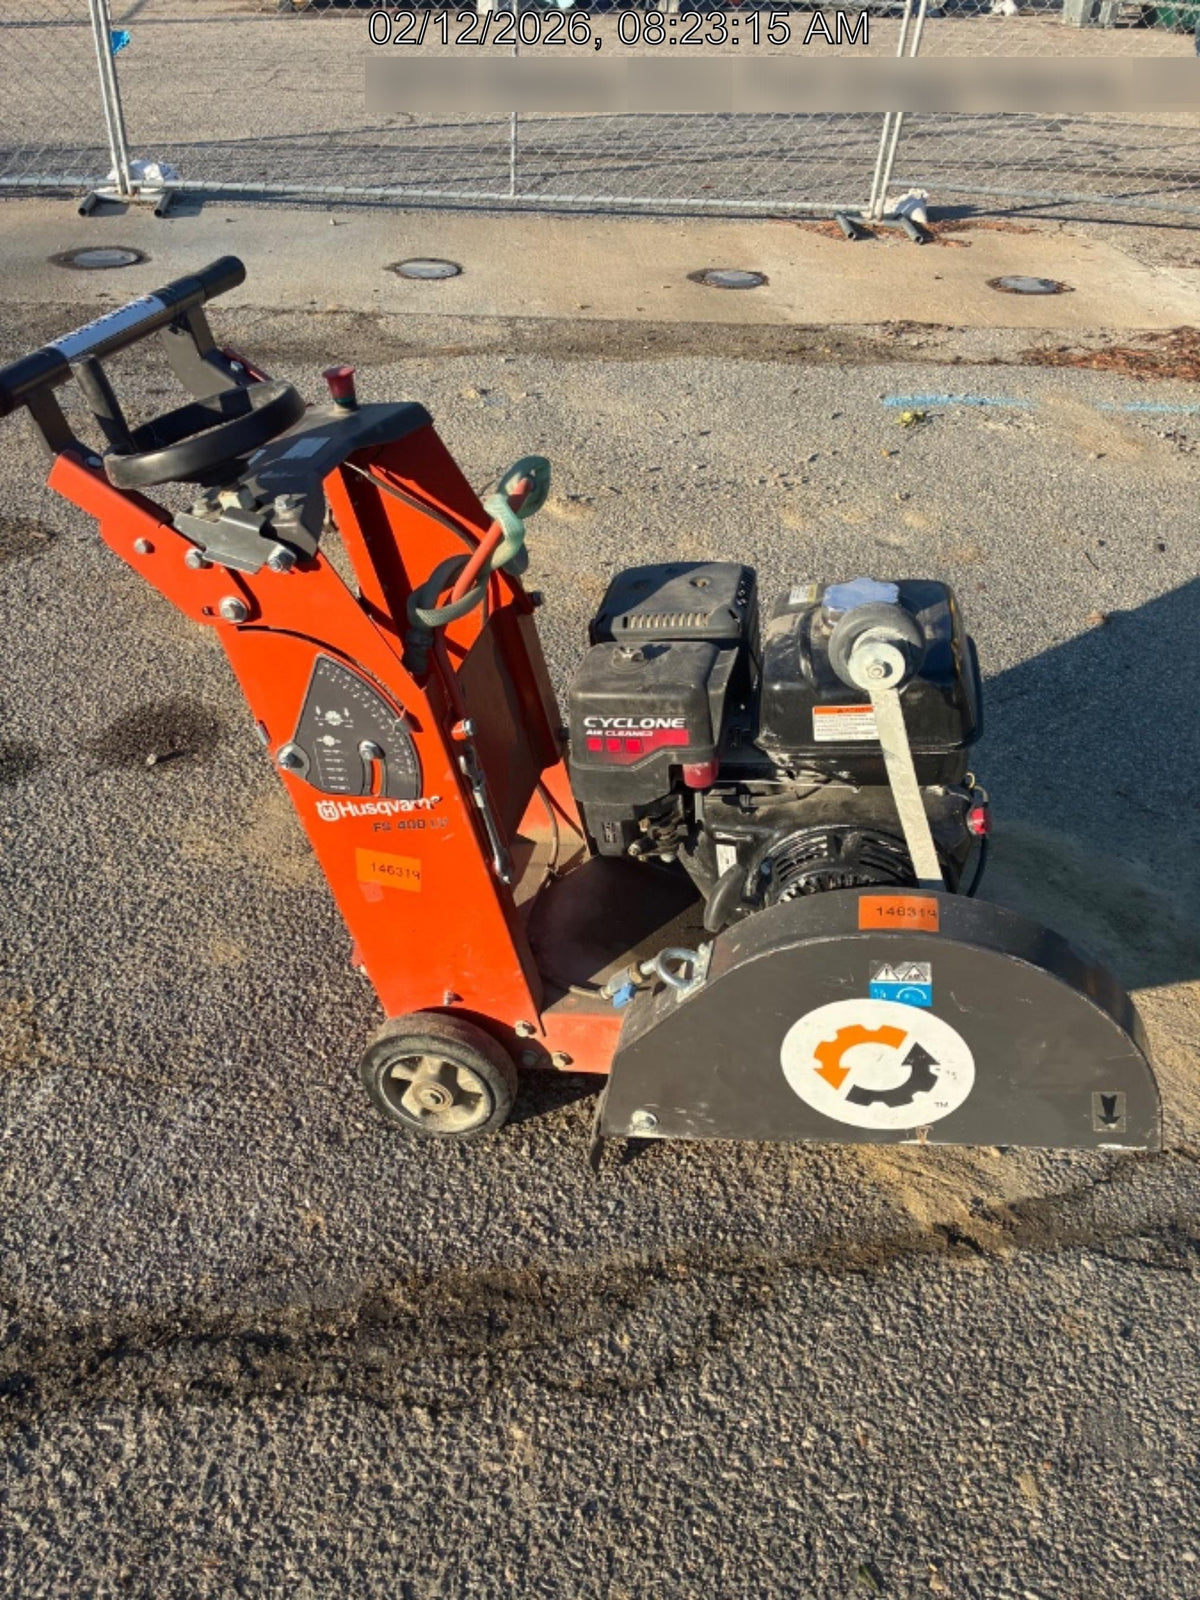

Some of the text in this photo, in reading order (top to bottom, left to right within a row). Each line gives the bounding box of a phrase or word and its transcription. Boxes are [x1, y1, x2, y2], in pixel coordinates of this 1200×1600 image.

[584, 717, 686, 729] CYCLONE
[373, 821, 391, 832] FS
[397, 818, 426, 830] 400
[372, 863, 421, 881] 146319
